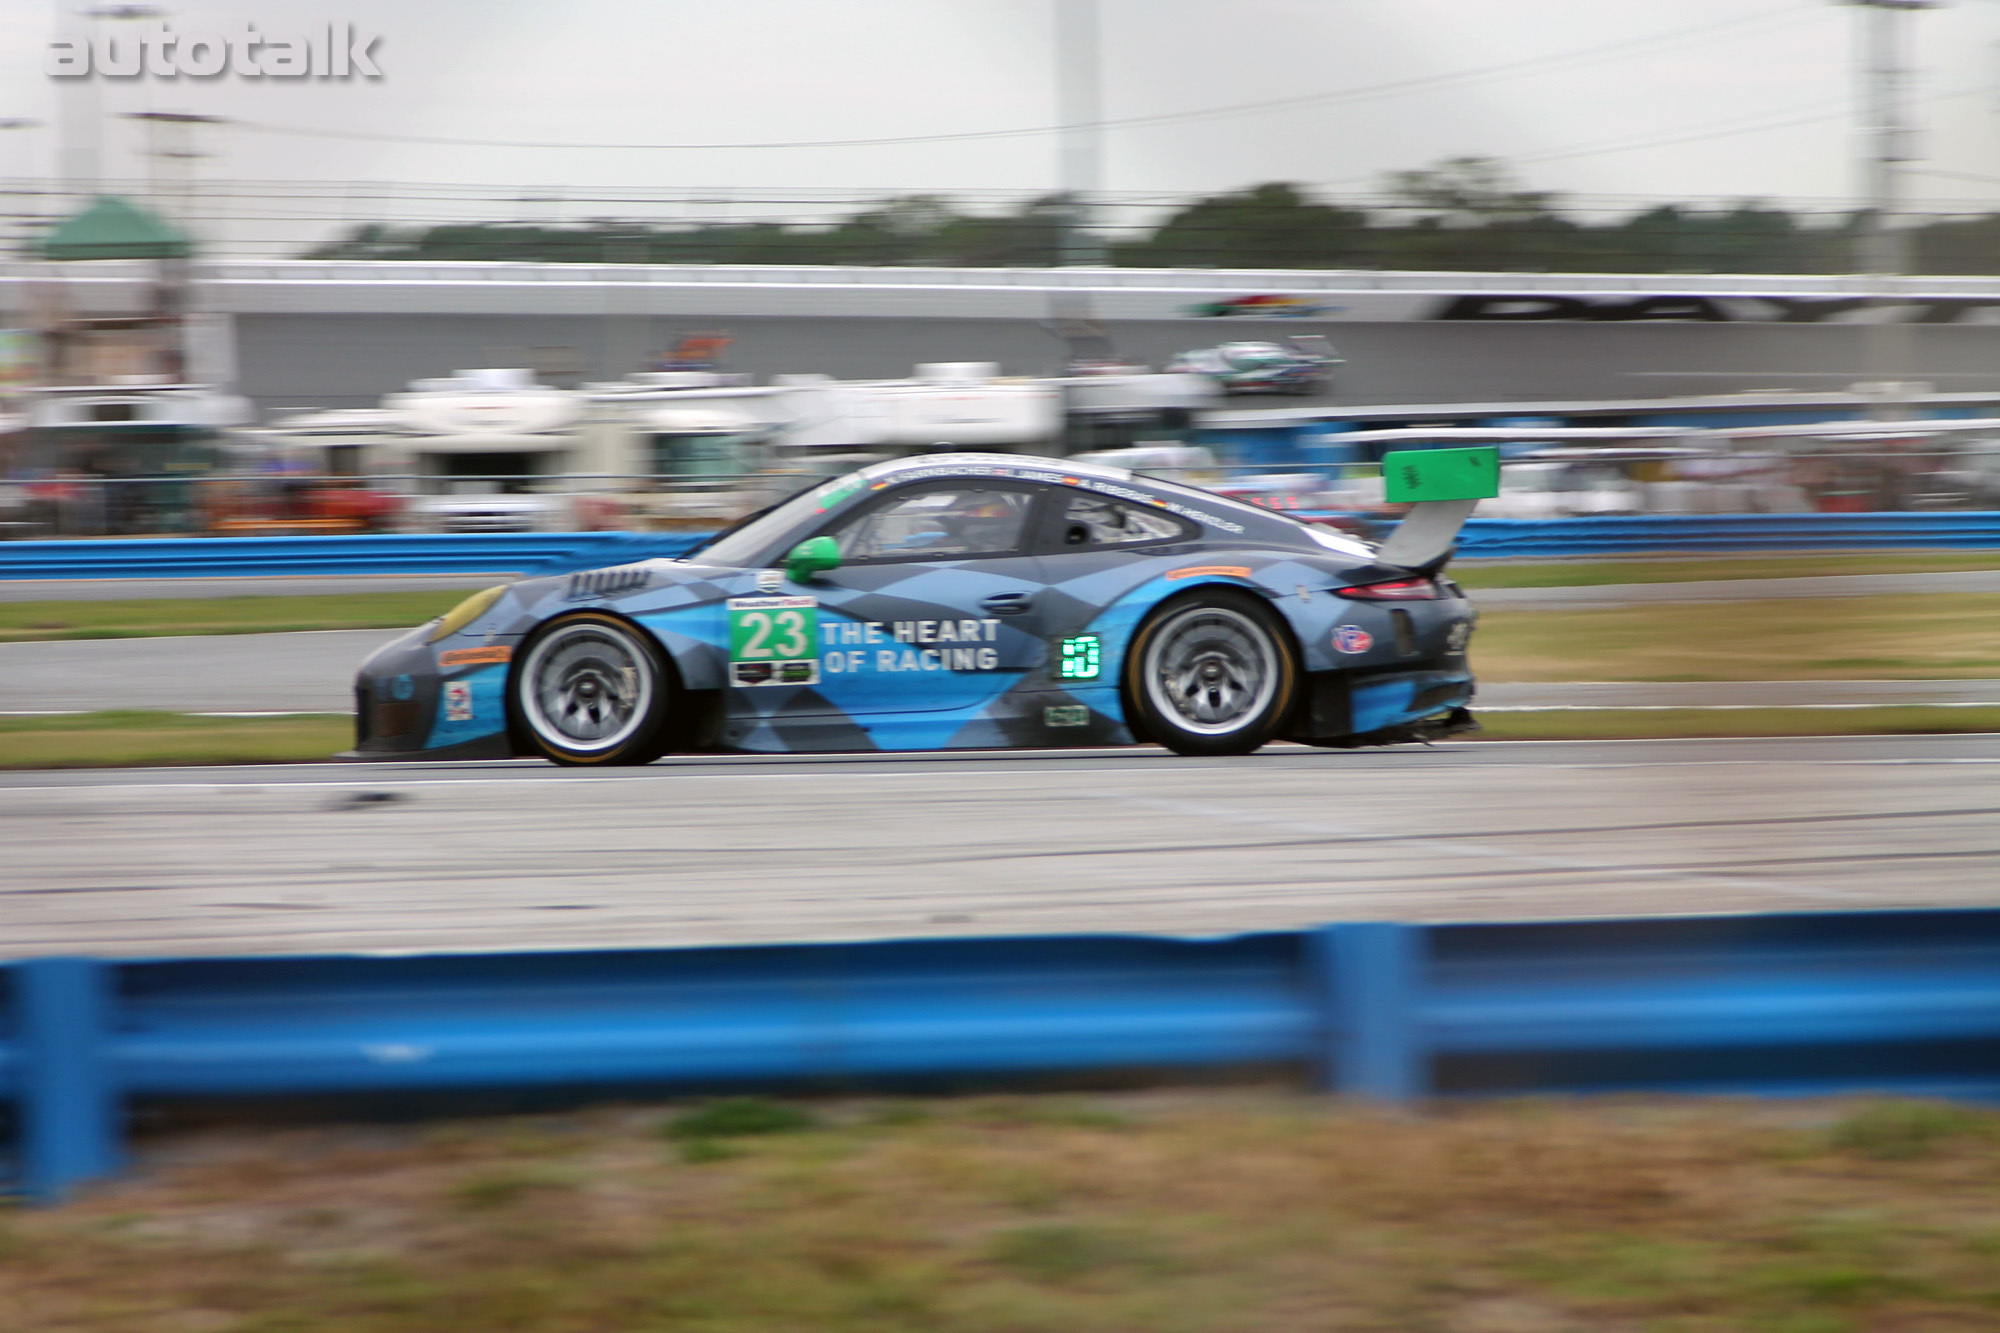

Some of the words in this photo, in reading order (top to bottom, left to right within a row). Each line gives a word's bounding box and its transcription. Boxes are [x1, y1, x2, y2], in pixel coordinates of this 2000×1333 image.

[738, 611, 809, 658] 23
[819, 621, 884, 645] THE
[893, 619, 1001, 643] HEART
[824, 650, 866, 673] OF
[876, 647, 999, 672] RACING
